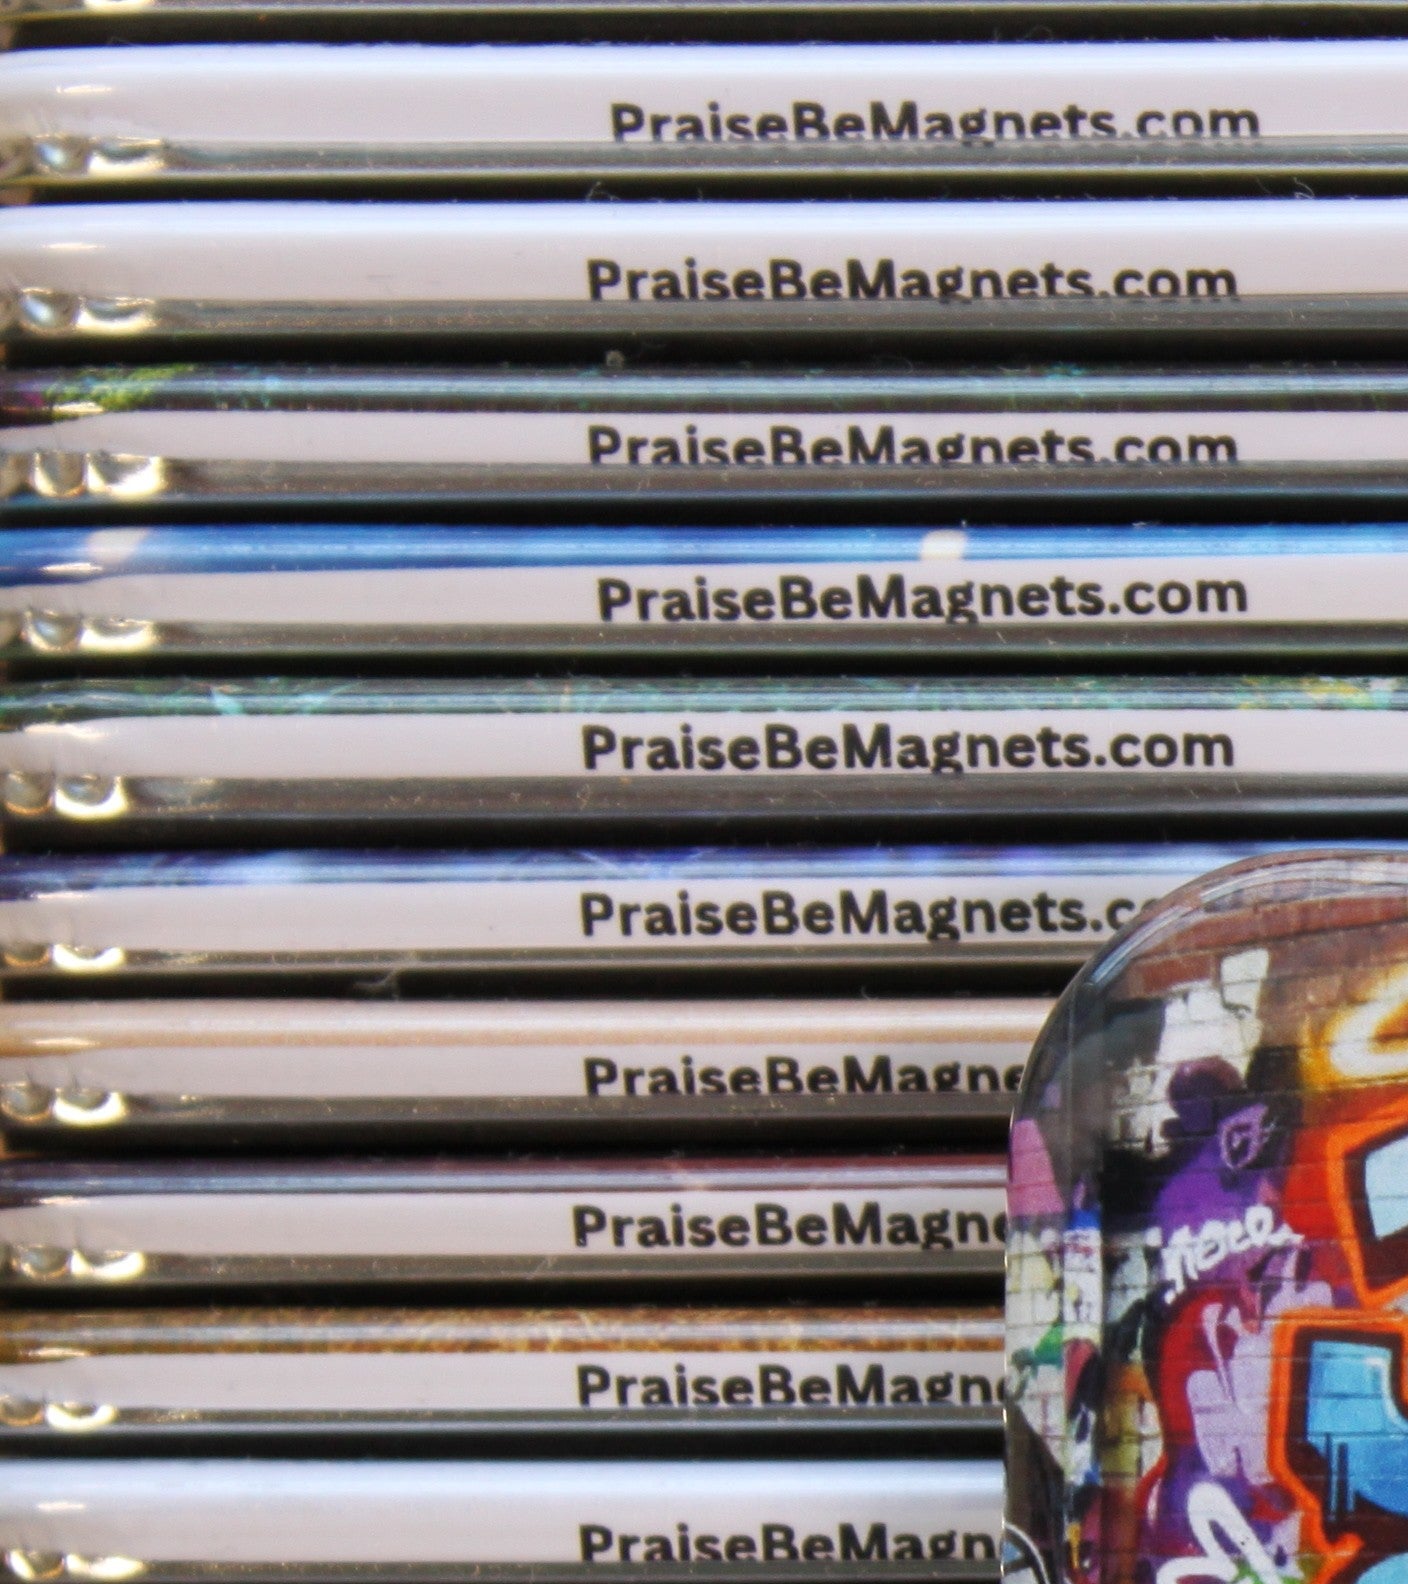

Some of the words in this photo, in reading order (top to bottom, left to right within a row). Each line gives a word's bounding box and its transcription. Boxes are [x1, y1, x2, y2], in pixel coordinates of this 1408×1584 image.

[586, 257, 1239, 303] PraiseBeMagnets.com
[598, 574, 1248, 624] PraiseBeMagnets.com
[581, 722, 1235, 773] PraiseBeMagnets.com
[579, 889, 1165, 942] PraiseBeMagnets.c
[584, 1054, 1024, 1096] PraiseBeMagne
[579, 1522, 1001, 1563] PraiseBeMagn
